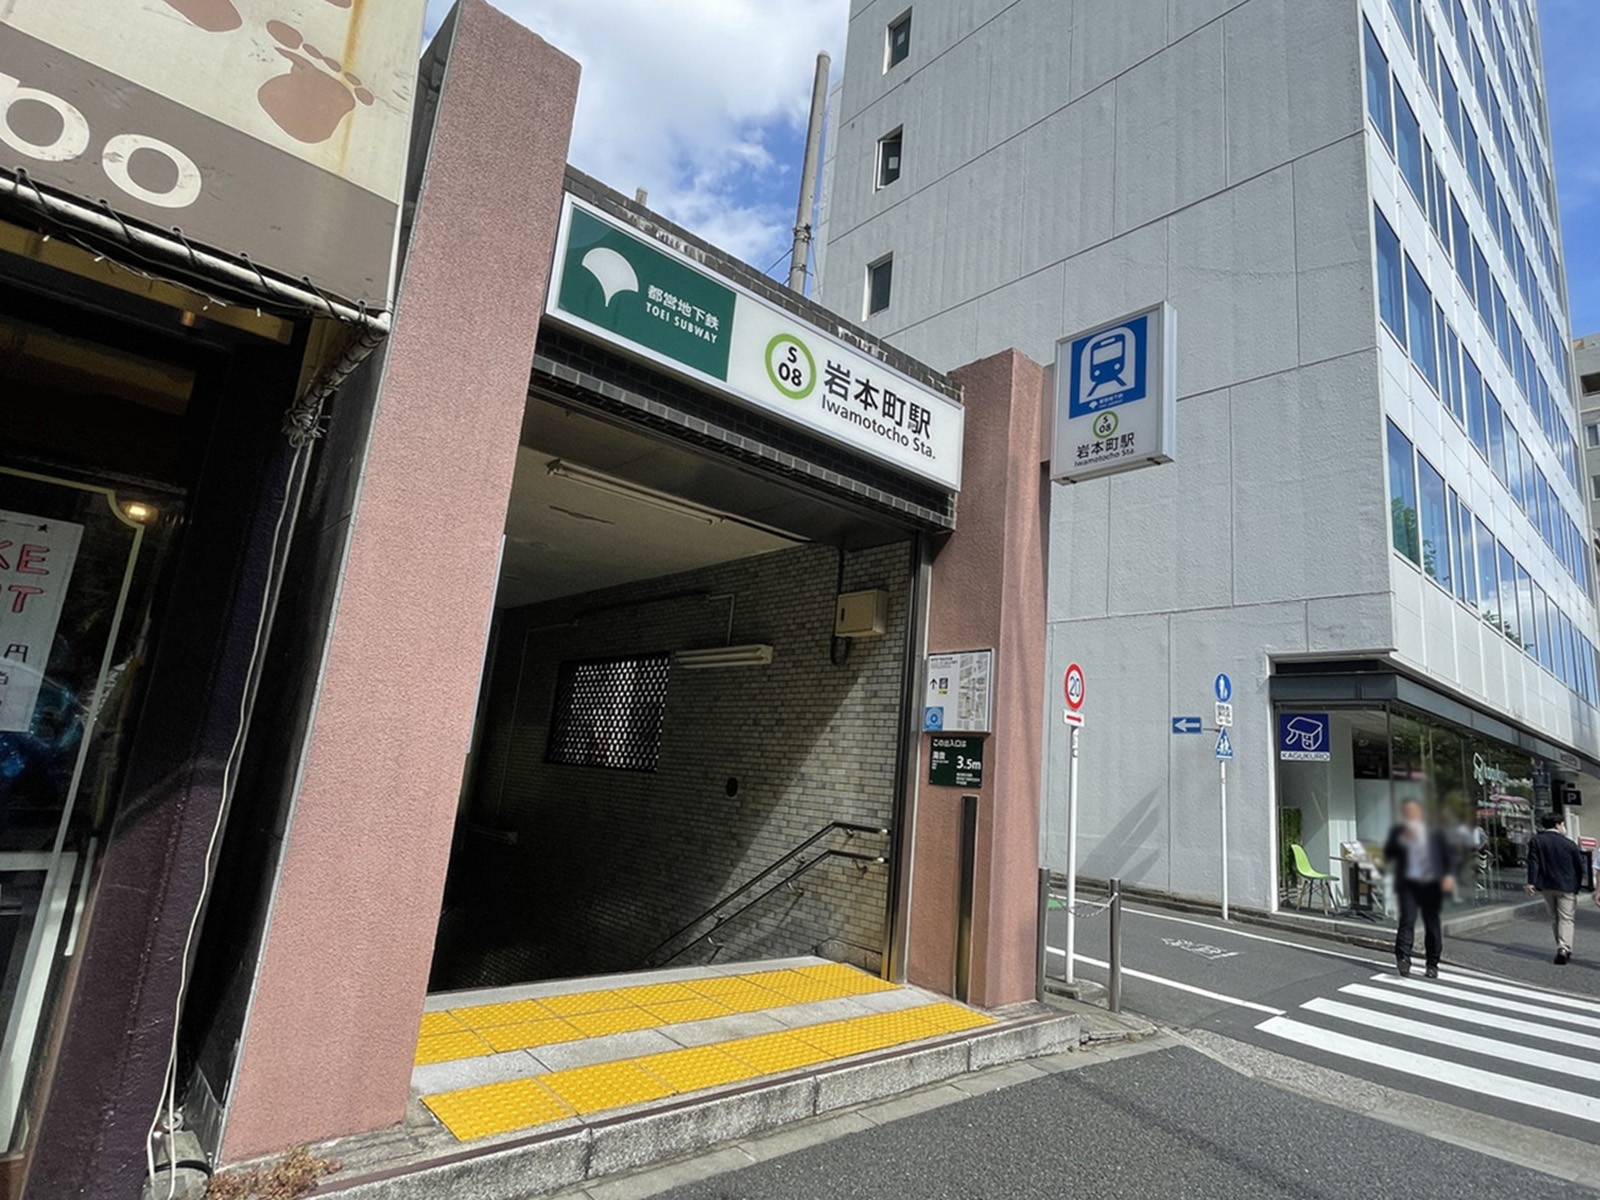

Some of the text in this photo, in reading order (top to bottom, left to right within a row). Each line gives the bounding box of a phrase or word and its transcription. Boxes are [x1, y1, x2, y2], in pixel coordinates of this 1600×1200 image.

[648, 284, 720, 332] 都営地下鉄
[645, 302, 718, 344] TOEI SUBWAY
[787, 346, 797, 364] S
[778, 362, 803, 387] 08
[824, 359, 931, 440] 岩本町駅
[821, 394, 936, 459] Iwamotocho Sta.
[1099, 423, 1112, 433] 08
[1103, 415, 1109, 424] S
[1076, 432, 1135, 459] 岩本町駅
[1069, 676, 1082, 698] 20
[956, 755, 982, 771] 3.5m
[1566, 793, 1577, 804] P
